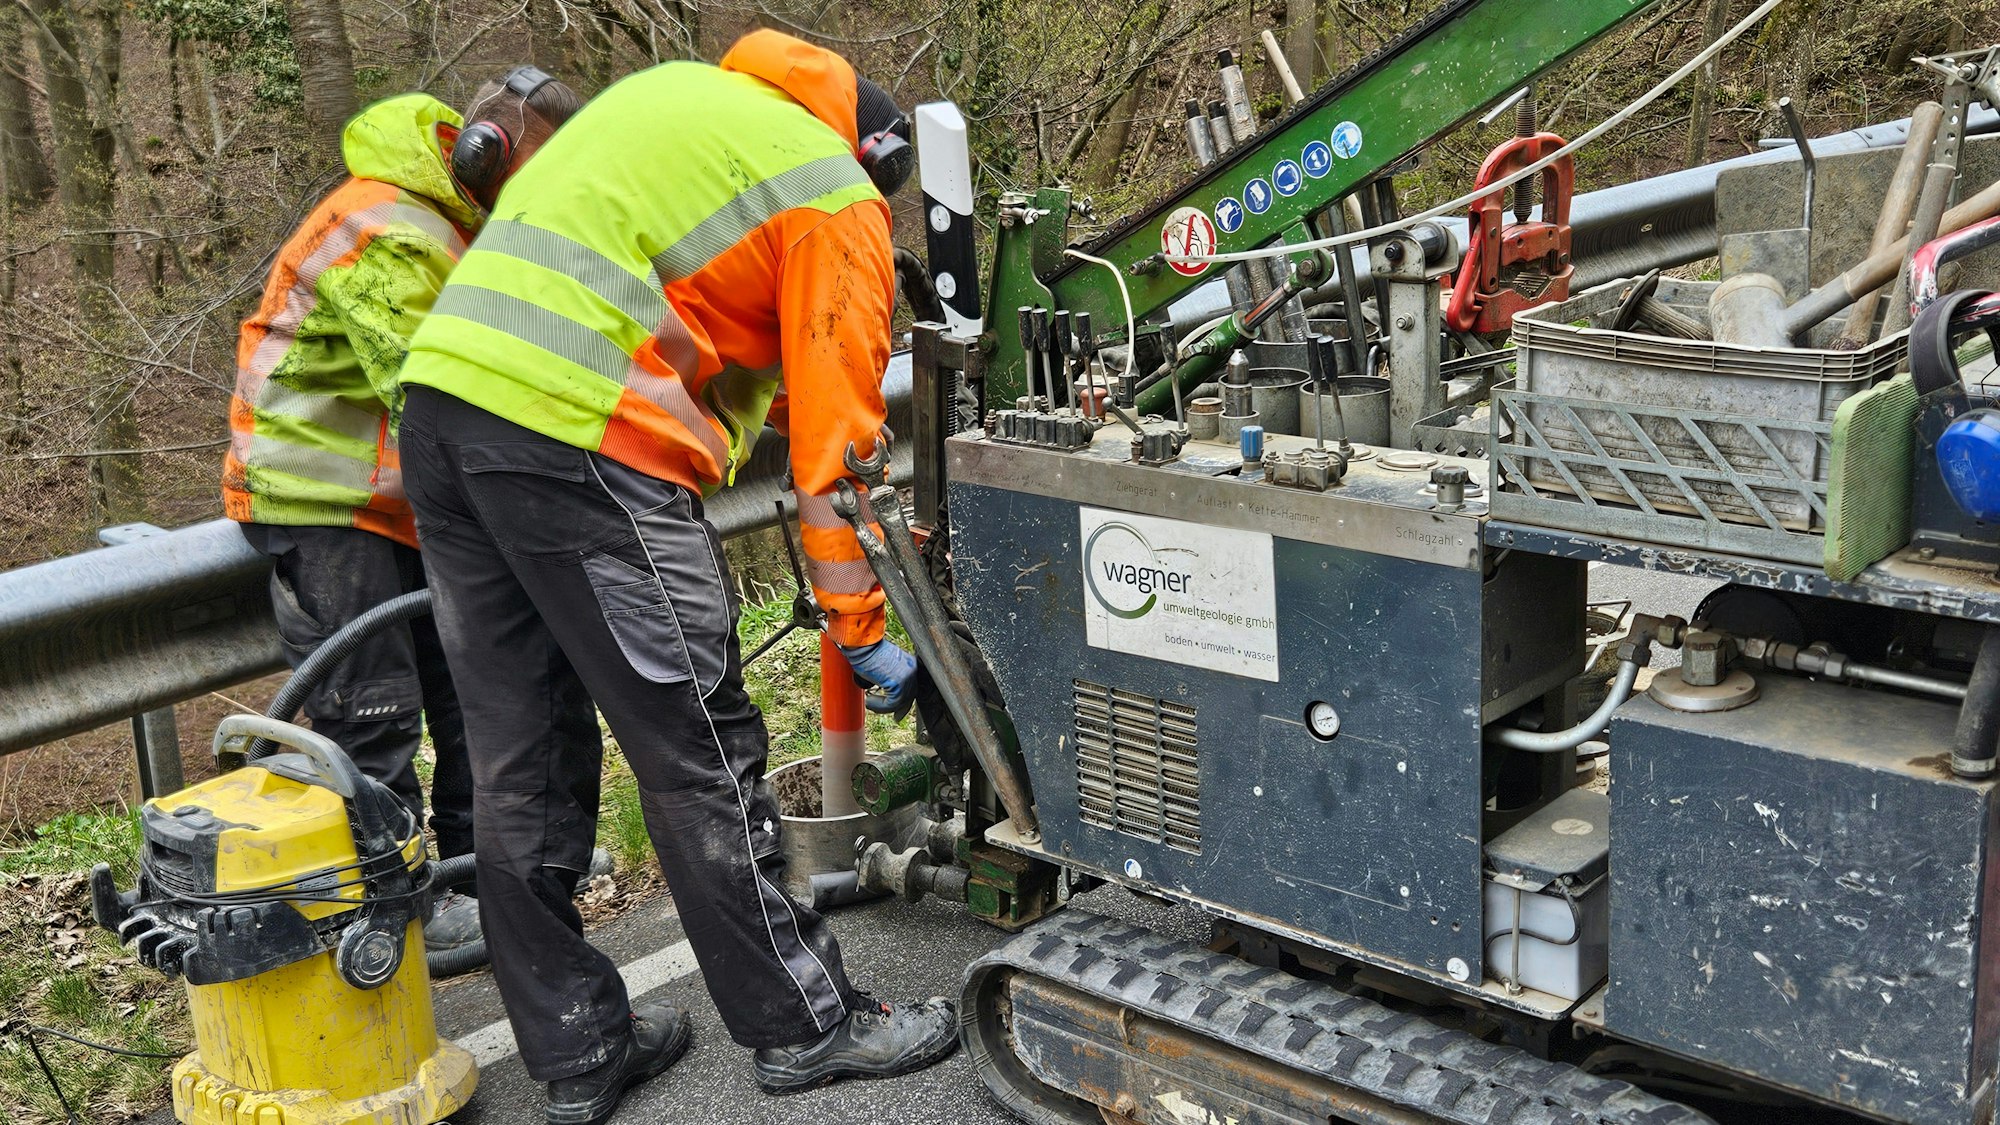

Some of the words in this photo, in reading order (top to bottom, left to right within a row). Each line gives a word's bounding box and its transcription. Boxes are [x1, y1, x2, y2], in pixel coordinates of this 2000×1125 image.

[1197, 494, 1232, 509] Auflast
[1248, 502, 1321, 524] Kette-Hammer
[1395, 526, 1454, 546] Schlagzahl
[1103, 560, 1192, 594] wagner
[1163, 601, 1243, 625] umweltgeologie
[1245, 614, 1275, 630] gmbh
[1165, 632, 1193, 648] boden
[1201, 641, 1235, 656] umwelt
[1243, 649, 1276, 663] wasser
